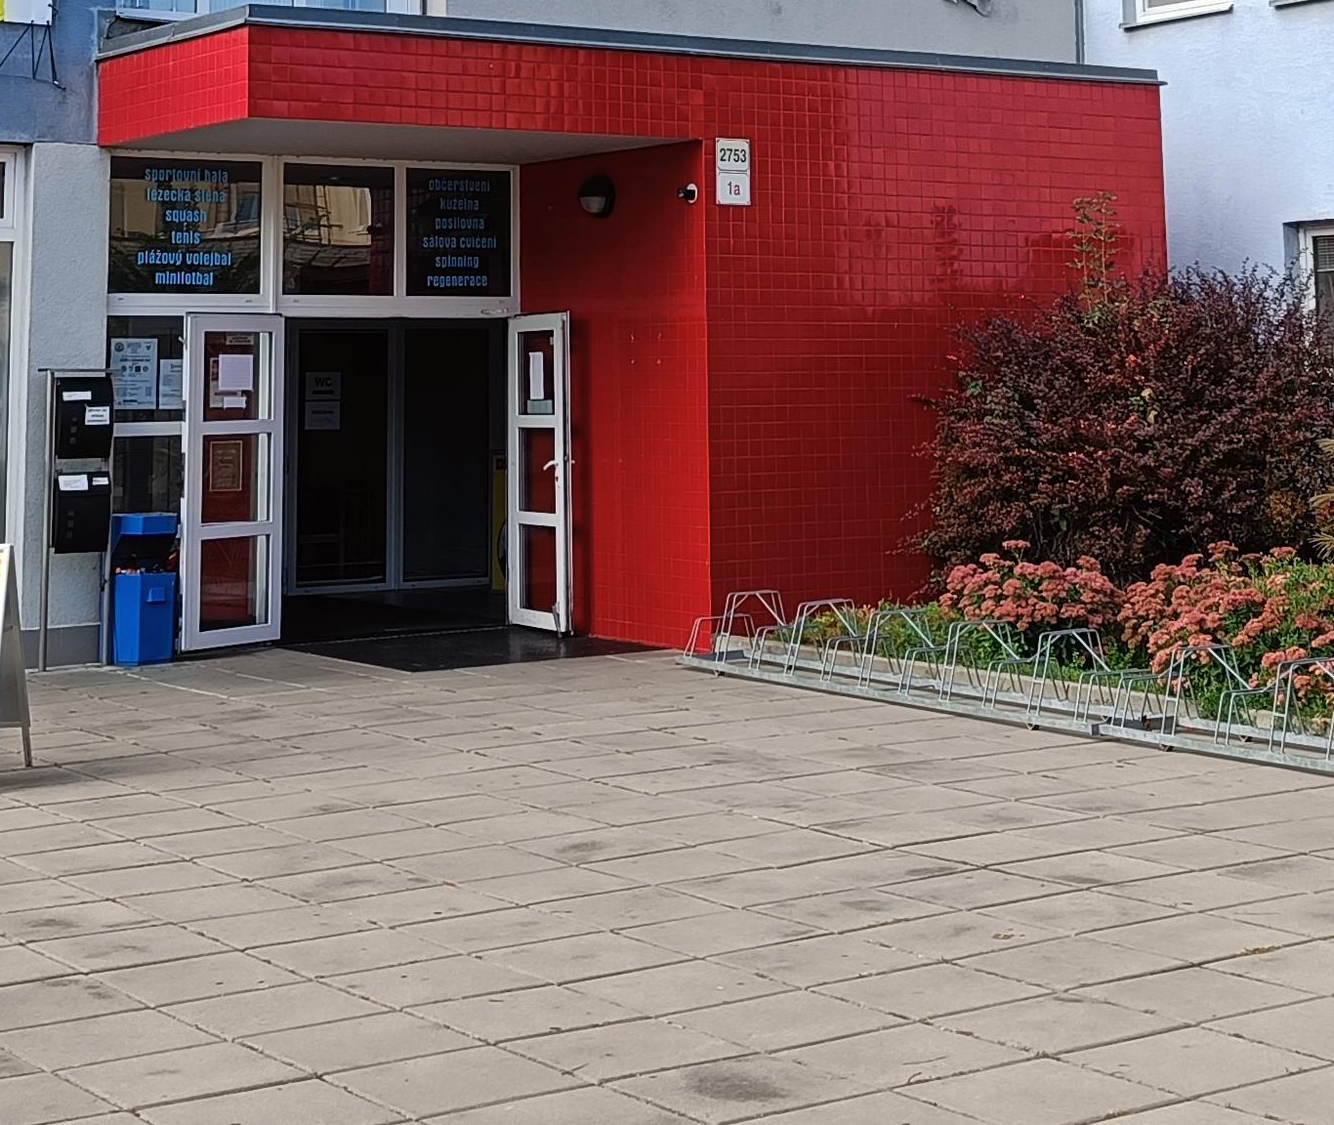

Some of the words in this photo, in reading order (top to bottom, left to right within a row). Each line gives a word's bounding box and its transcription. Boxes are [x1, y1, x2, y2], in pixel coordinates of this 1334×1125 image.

[719, 148, 747, 163] 2753
[727, 181, 741, 195] 1a
[165, 209, 207, 223] squash
[435, 217, 485, 230] posilovna
[171, 231, 200, 244] tenis
[186, 251, 231, 266] volejbal
[435, 256, 479, 268] spinning
[155, 271, 214, 286] minifotbal
[427, 275, 488, 288] regenerace
[314, 377, 332, 388] WC
